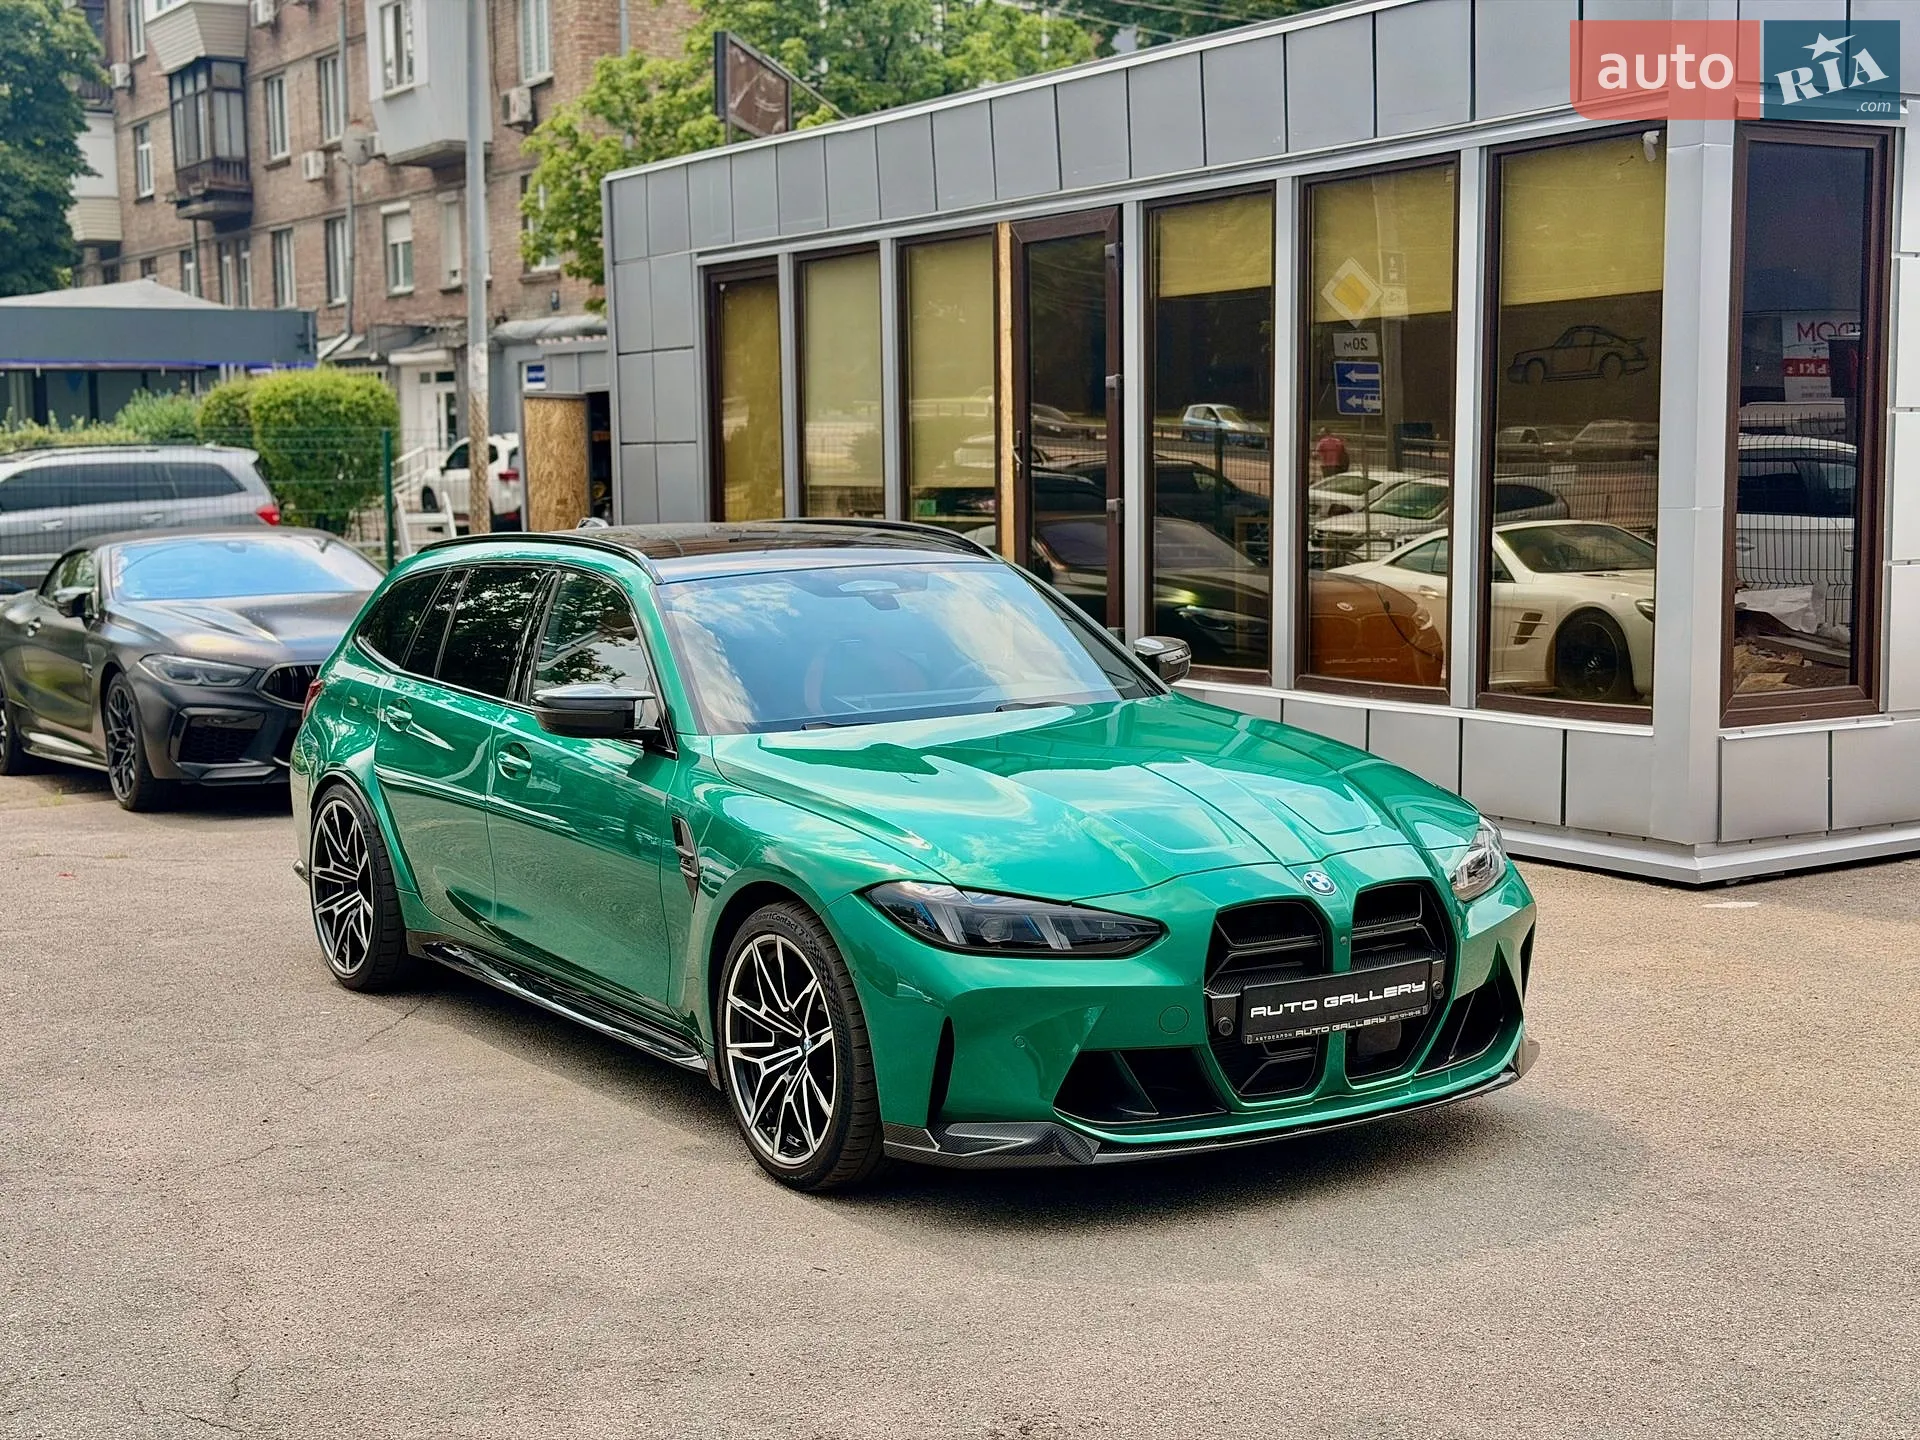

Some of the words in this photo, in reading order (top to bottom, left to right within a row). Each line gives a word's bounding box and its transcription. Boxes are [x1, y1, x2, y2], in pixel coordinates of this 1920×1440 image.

[1250, 999, 1318, 1018] AUTO
[1324, 981, 1426, 1008] GALLERY
[1295, 1025, 1330, 1037] AUTO
[1331, 1015, 1387, 1031] GALLERY
